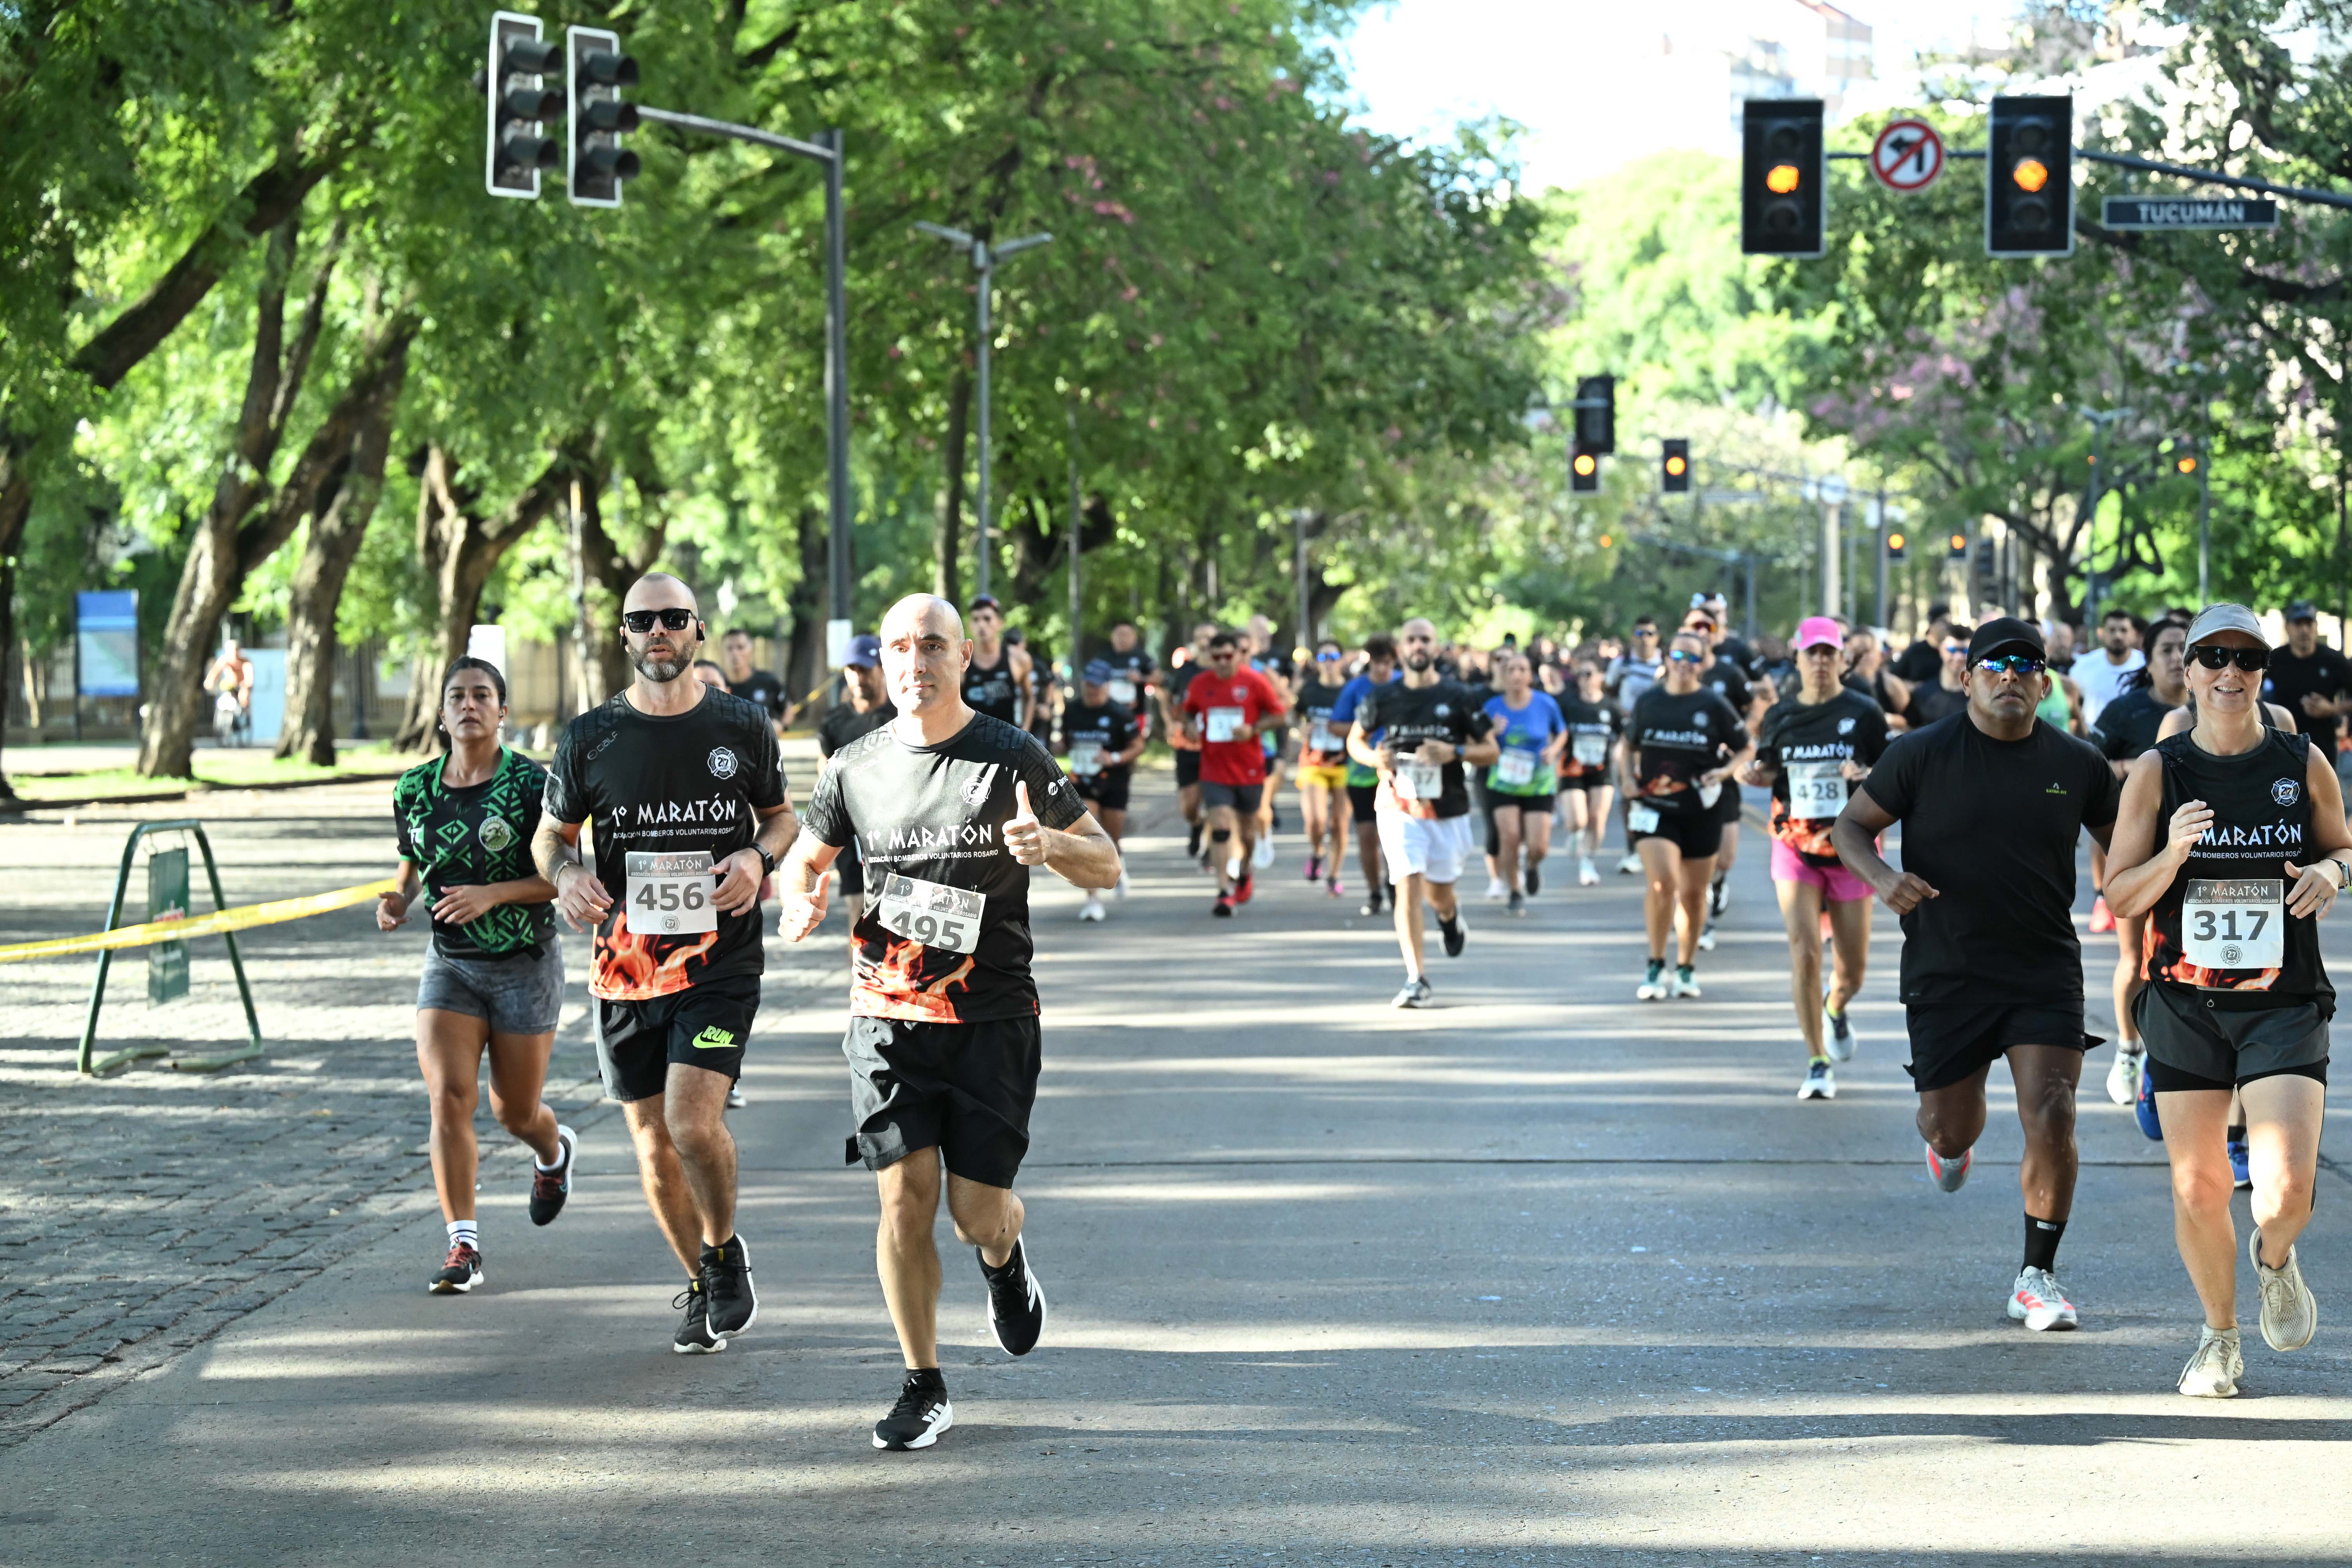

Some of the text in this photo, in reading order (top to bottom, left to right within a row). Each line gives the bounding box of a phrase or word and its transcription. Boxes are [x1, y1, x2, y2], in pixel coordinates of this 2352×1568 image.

[718, 757, 728, 766] 27
[1797, 782, 1838, 800] 428
[637, 793, 735, 825] MARATÓN
[888, 818, 992, 849] MARATÓN
[2198, 818, 2301, 846] MARATÓN
[650, 856, 702, 870] MARATÓN
[894, 853, 928, 862] BOMBEROS
[929, 851, 972, 859] VOLUNTARIOS
[973, 849, 998, 858] ROSARIO
[635, 882, 704, 911] 456
[2211, 883, 2268, 896] MARATÓN
[960, 910, 977, 919] ROSARIO
[891, 911, 964, 951] 495
[2194, 910, 2269, 941] 317
[702, 1025, 734, 1044] RUN
